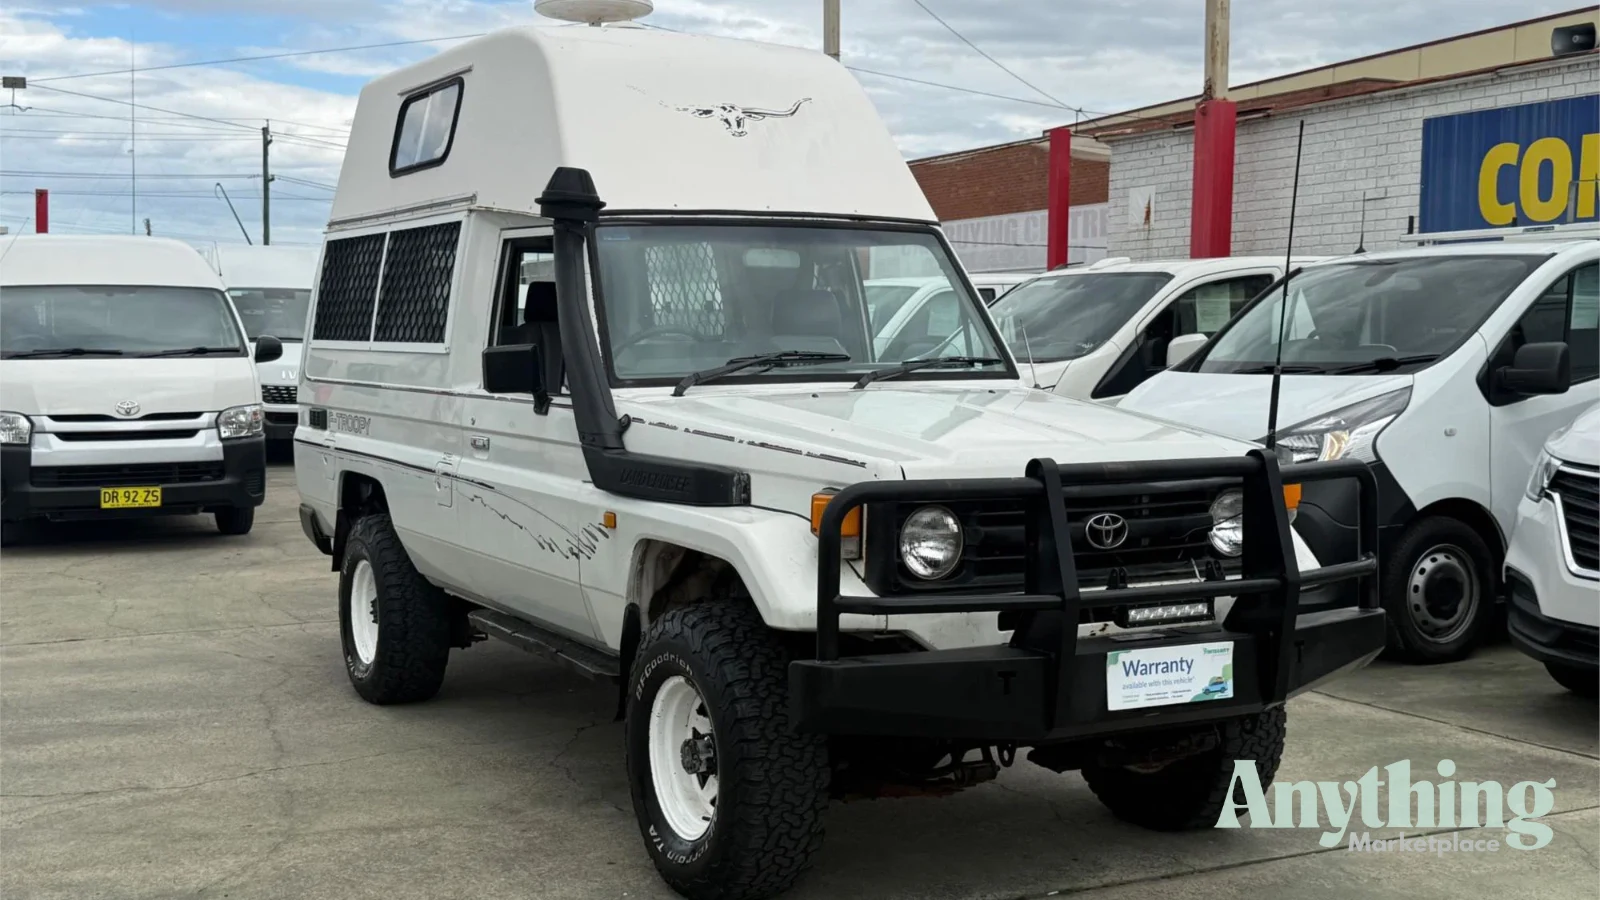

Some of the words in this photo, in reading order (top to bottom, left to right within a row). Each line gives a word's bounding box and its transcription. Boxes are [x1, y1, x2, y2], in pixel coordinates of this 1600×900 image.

[103, 491, 120, 504] DR
[123, 490, 139, 503] 92
[143, 489, 160, 503] ZS
[1122, 657, 1194, 677] Warranty
[635, 651, 692, 701] BFGoodrich
[1122, 679, 1148, 690] available
[1148, 678, 1161, 687] with
[1162, 677, 1173, 686] this
